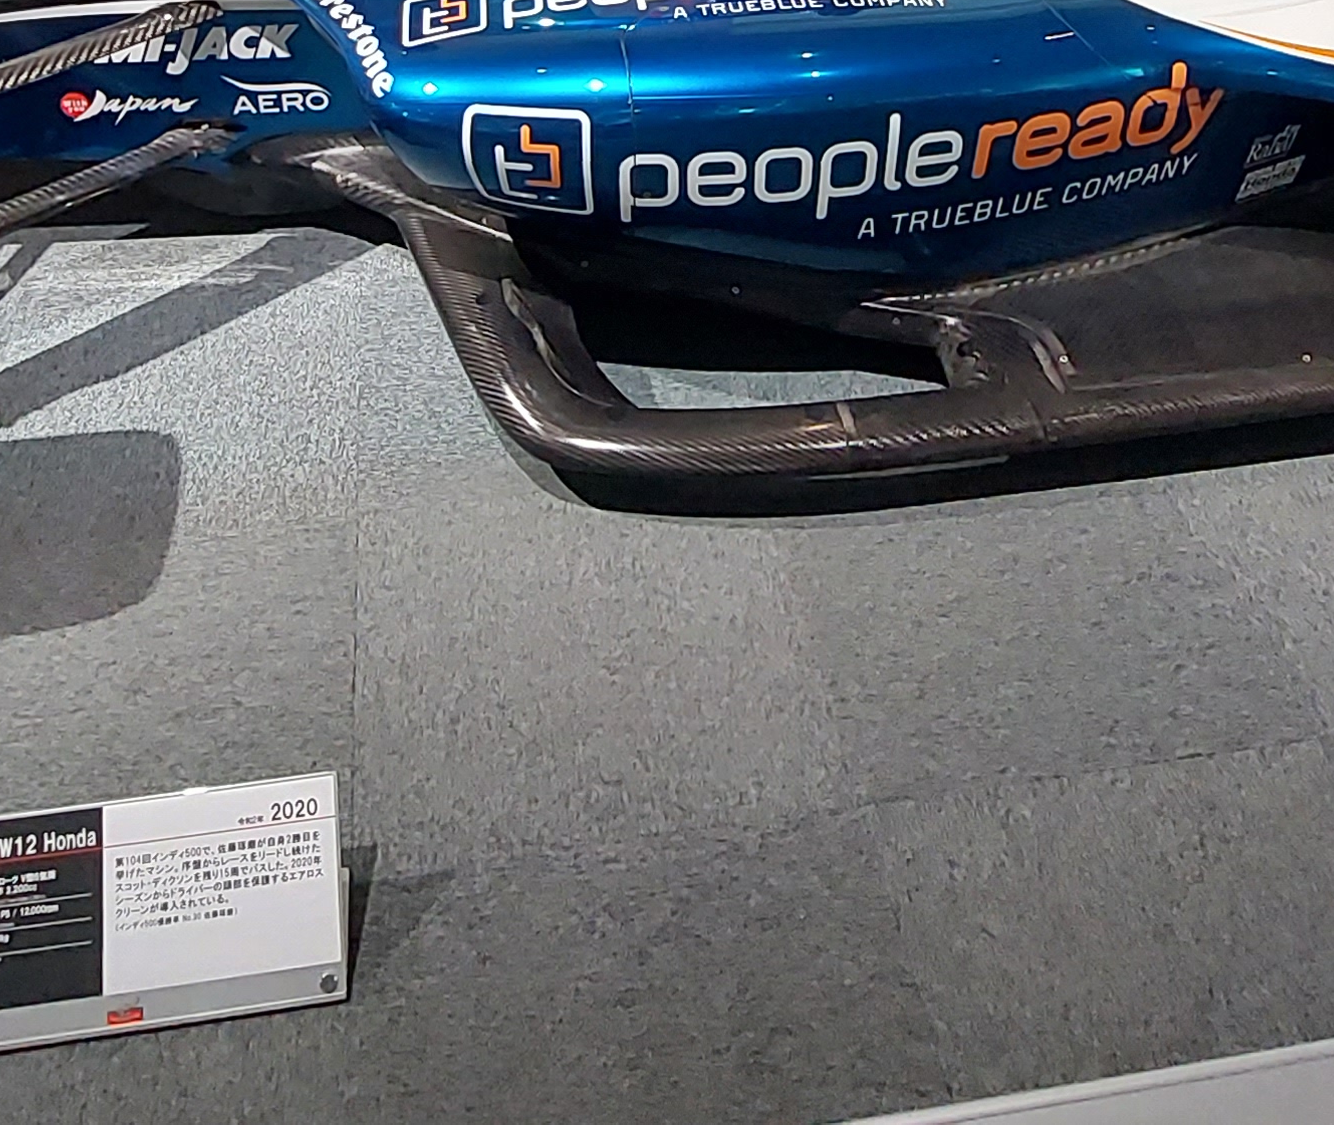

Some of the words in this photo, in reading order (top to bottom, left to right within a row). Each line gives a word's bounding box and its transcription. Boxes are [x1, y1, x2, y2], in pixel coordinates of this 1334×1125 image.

[672, 5, 689, 19] A
[73, 89, 200, 126] Japan
[233, 91, 330, 116] AERO
[618, 62, 1225, 223] peopleready
[857, 216, 876, 240] A
[892, 189, 1050, 236] TRUEBLUE
[1061, 152, 1201, 206] COMPANY
[270, 797, 319, 821] 2020
[43, 827, 98, 853] Honda
